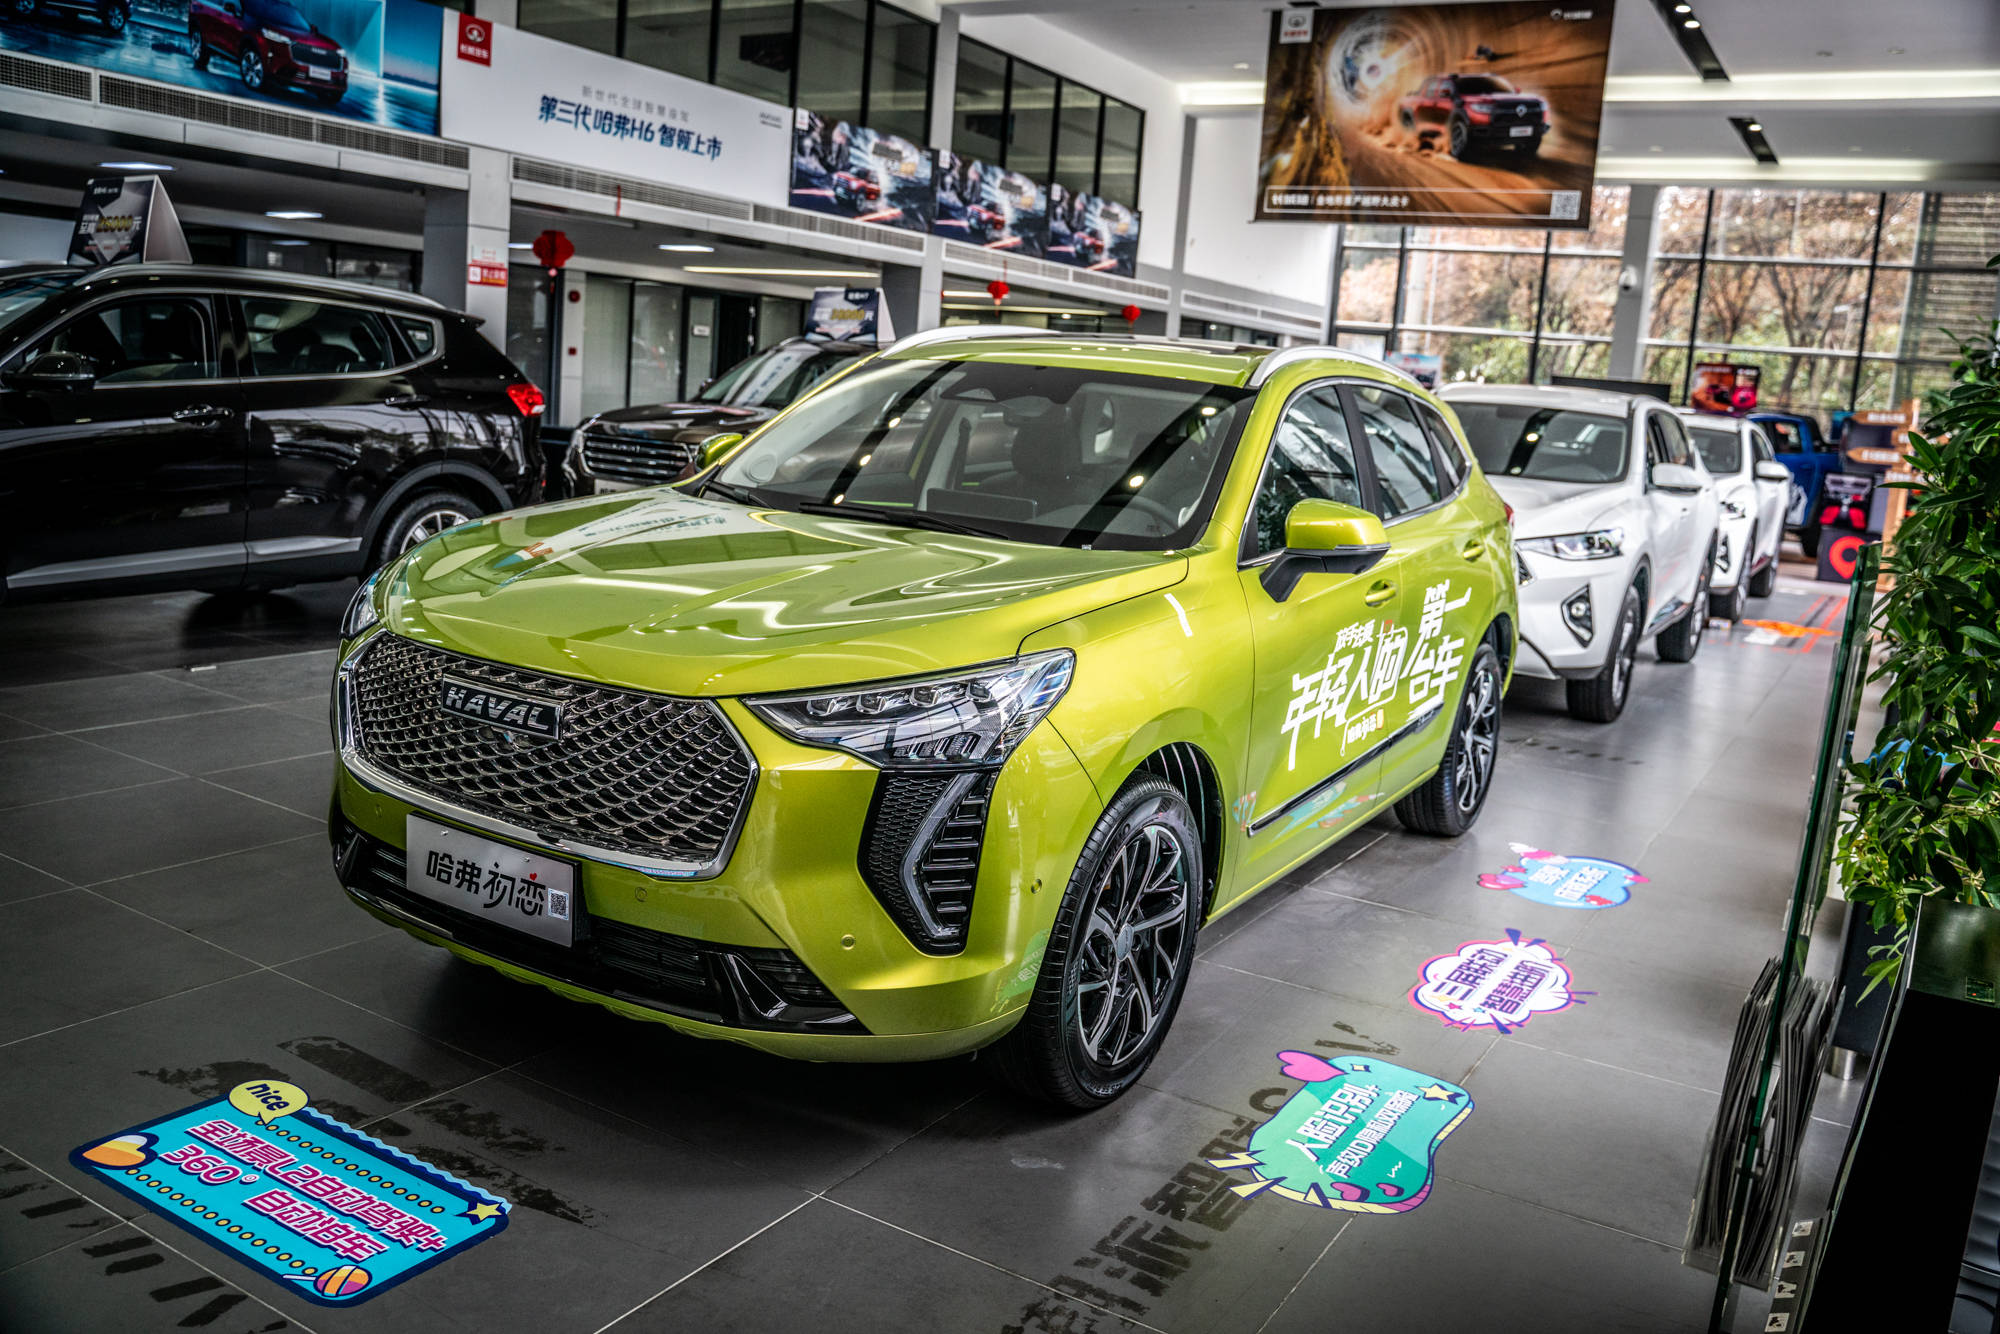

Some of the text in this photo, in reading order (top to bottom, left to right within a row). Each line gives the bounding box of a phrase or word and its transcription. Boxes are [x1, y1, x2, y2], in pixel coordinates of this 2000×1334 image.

[538, 95, 722, 161] 第三代哈弗H6 智领上市
[445, 685, 549, 731] HAVAL
[426, 850, 546, 917] 哈弗初恋
[1432, 948, 1508, 1001] 三屏联动
[246, 1083, 290, 1112] nice
[245, 1188, 389, 1262] 自动泊车
